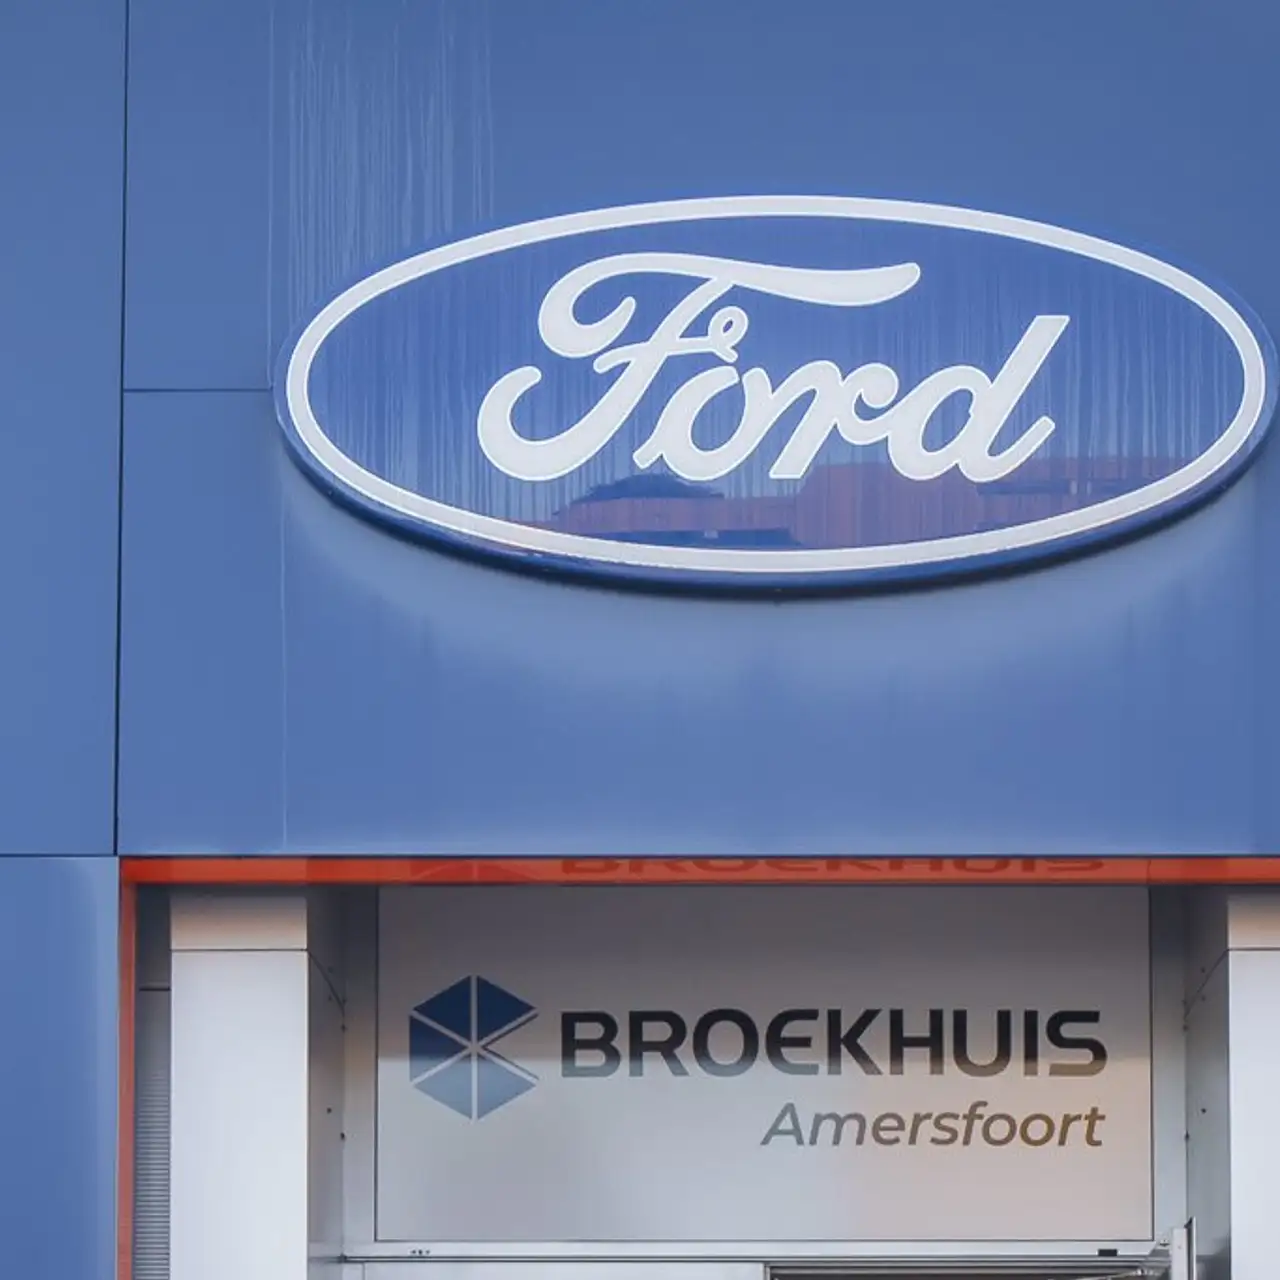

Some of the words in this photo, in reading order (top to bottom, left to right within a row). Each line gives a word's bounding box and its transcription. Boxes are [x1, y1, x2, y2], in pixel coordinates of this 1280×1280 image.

[477, 252, 1070, 482] Ford
[561, 1008, 1108, 1078] BROEKHUIS
[760, 1100, 1106, 1147] Amersfoort
